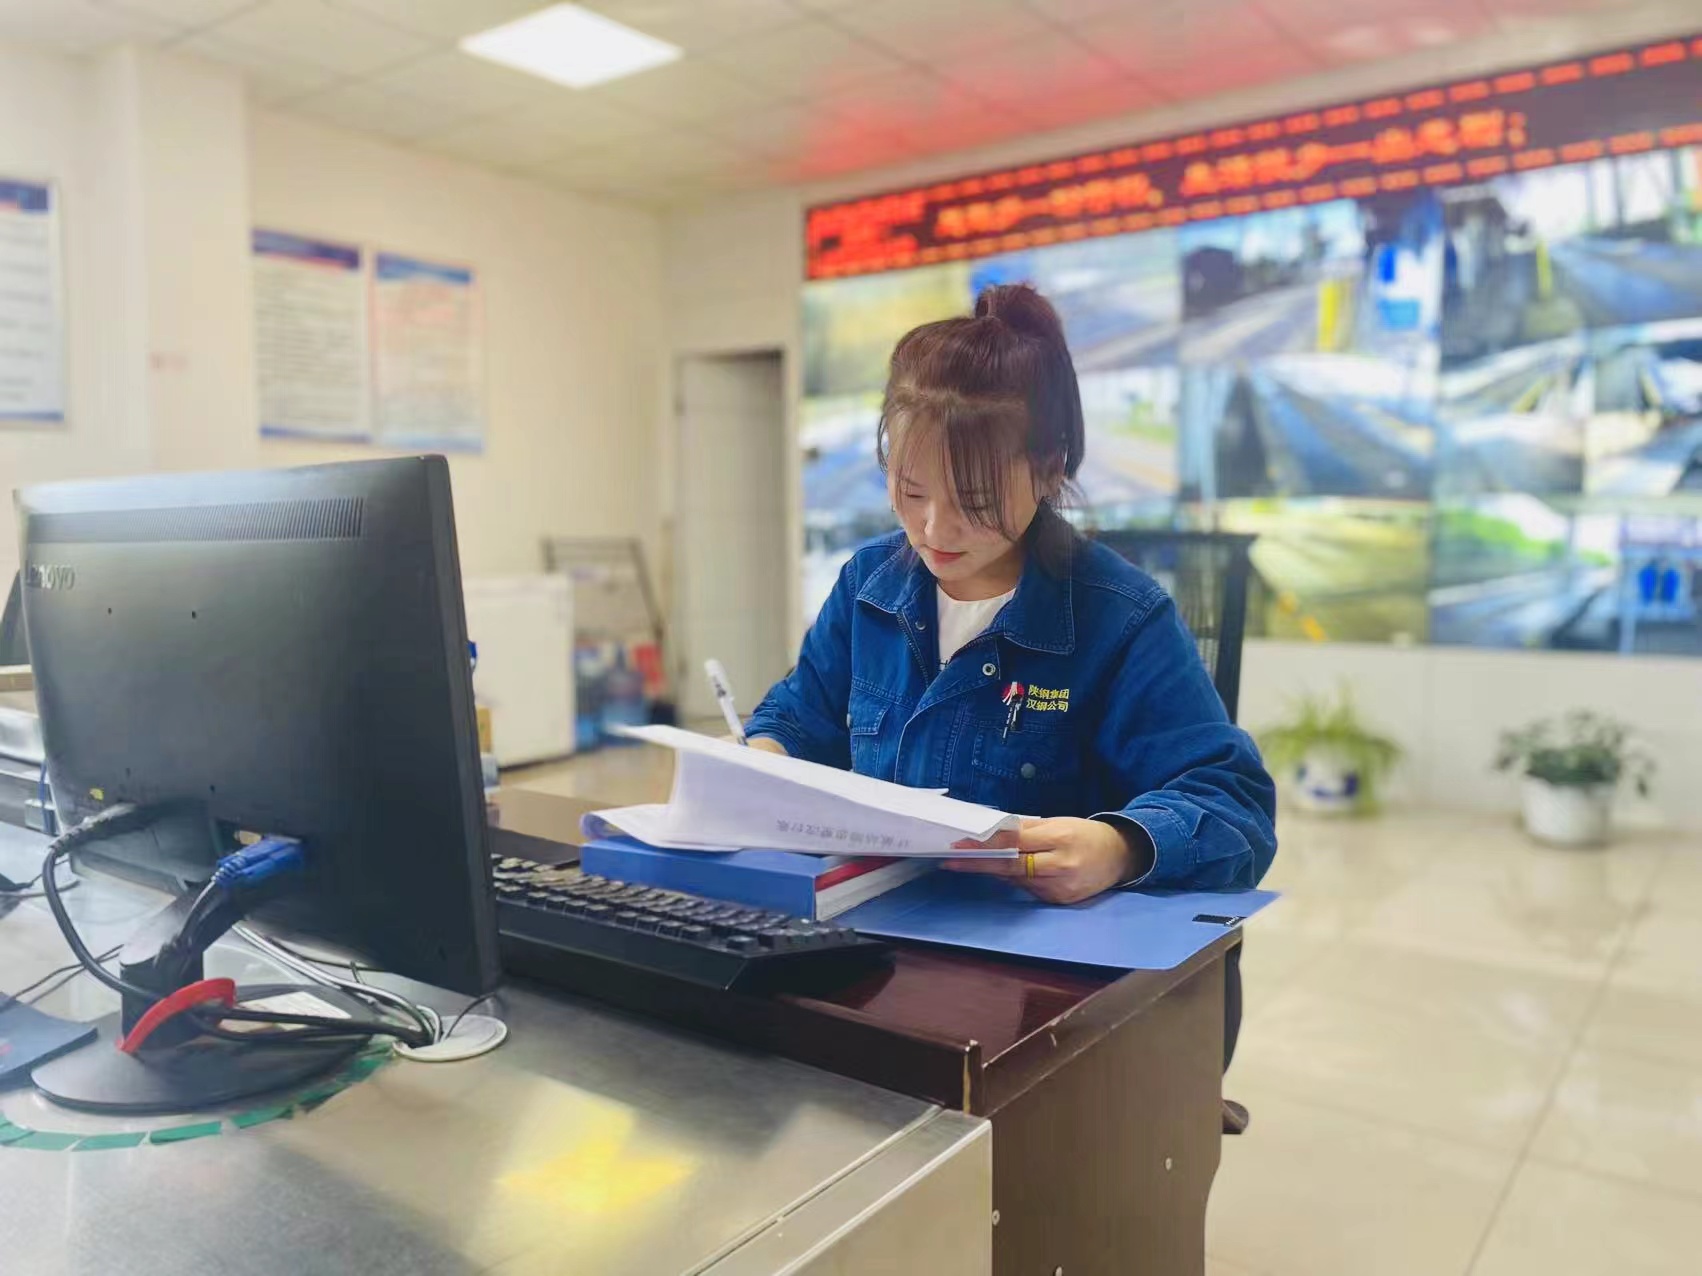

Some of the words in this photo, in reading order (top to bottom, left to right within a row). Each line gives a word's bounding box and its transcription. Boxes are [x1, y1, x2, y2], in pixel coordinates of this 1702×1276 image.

[1028, 684, 1070, 700] 陕钢集团
[1026, 698, 1069, 712] 汉钢公司
